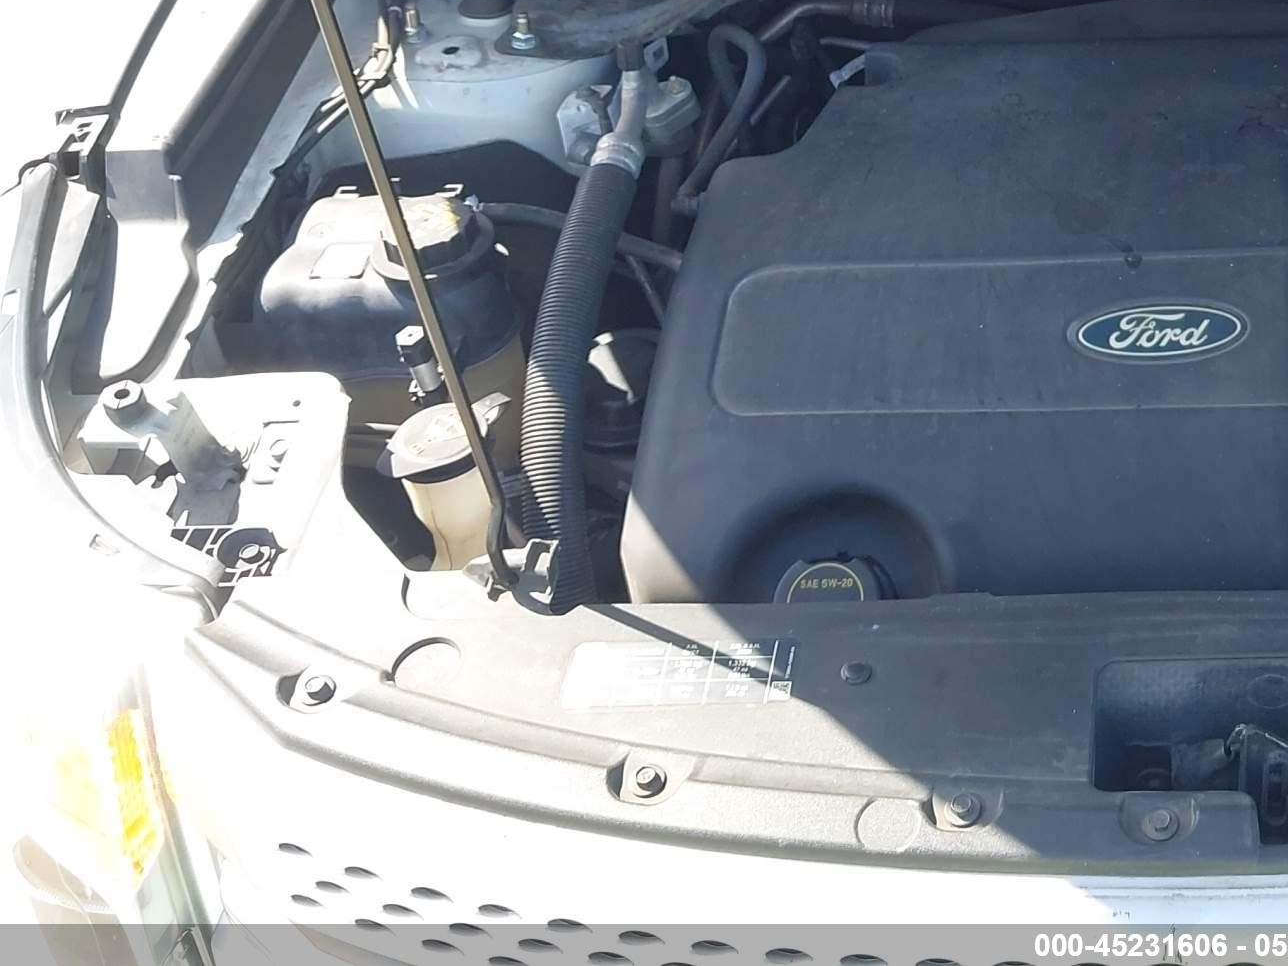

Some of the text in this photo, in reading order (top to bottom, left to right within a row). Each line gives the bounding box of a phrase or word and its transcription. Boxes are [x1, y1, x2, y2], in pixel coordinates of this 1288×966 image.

[1108, 312, 1210, 349] Ford
[800, 577, 854, 589] SAE 5W-20
